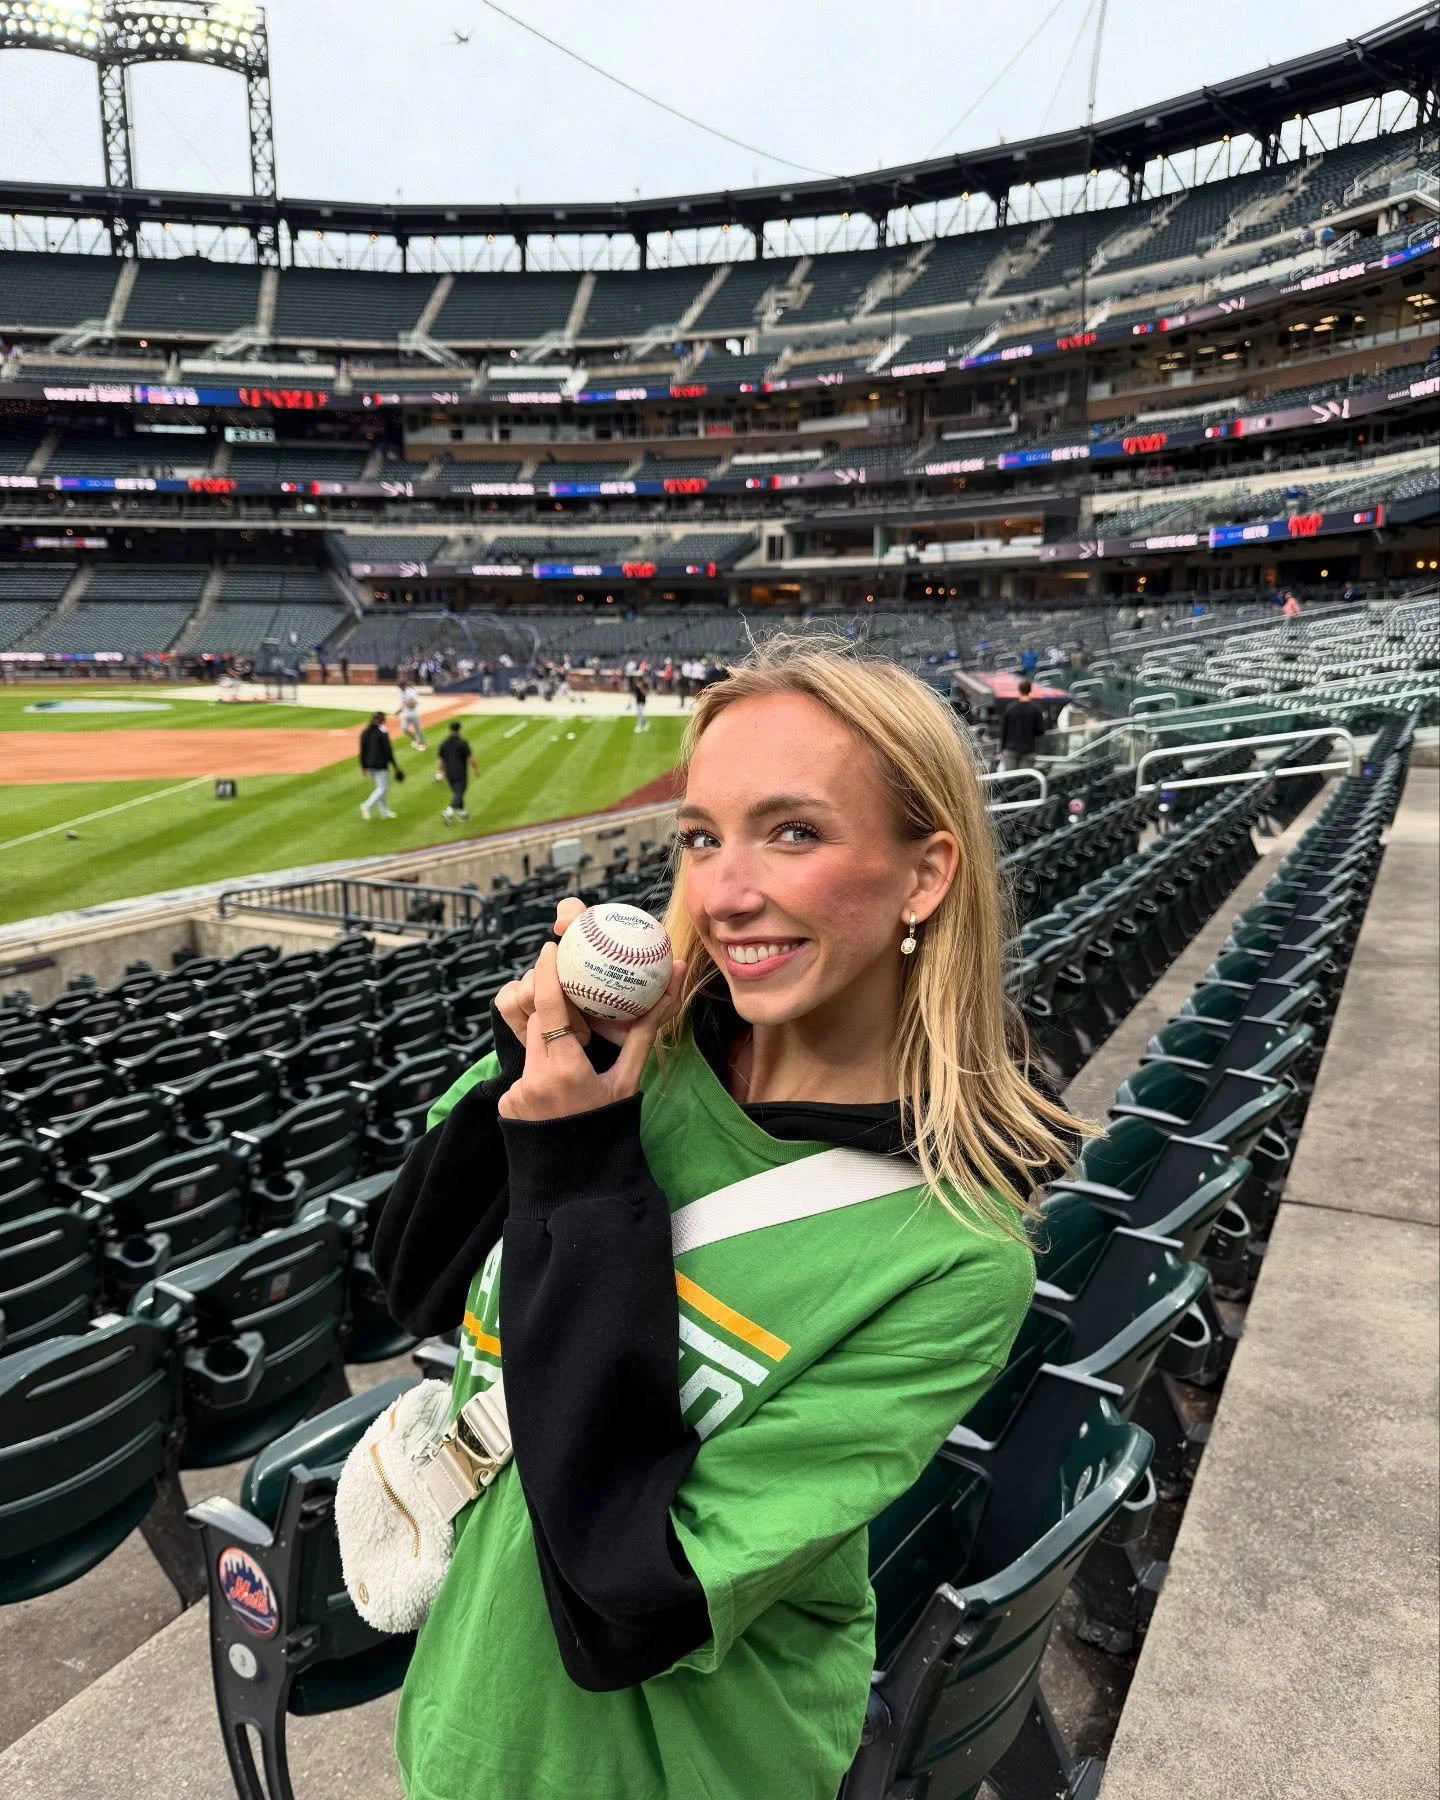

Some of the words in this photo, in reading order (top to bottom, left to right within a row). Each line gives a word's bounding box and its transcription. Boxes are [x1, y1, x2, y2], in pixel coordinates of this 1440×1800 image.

[605, 912, 655, 930] Rawlings
[584, 961, 604, 974] MAJOR
[604, 970, 623, 981] LEAGUE
[623, 976, 648, 987] BASEBALL
[609, 965, 629, 975] OFFICIAL
